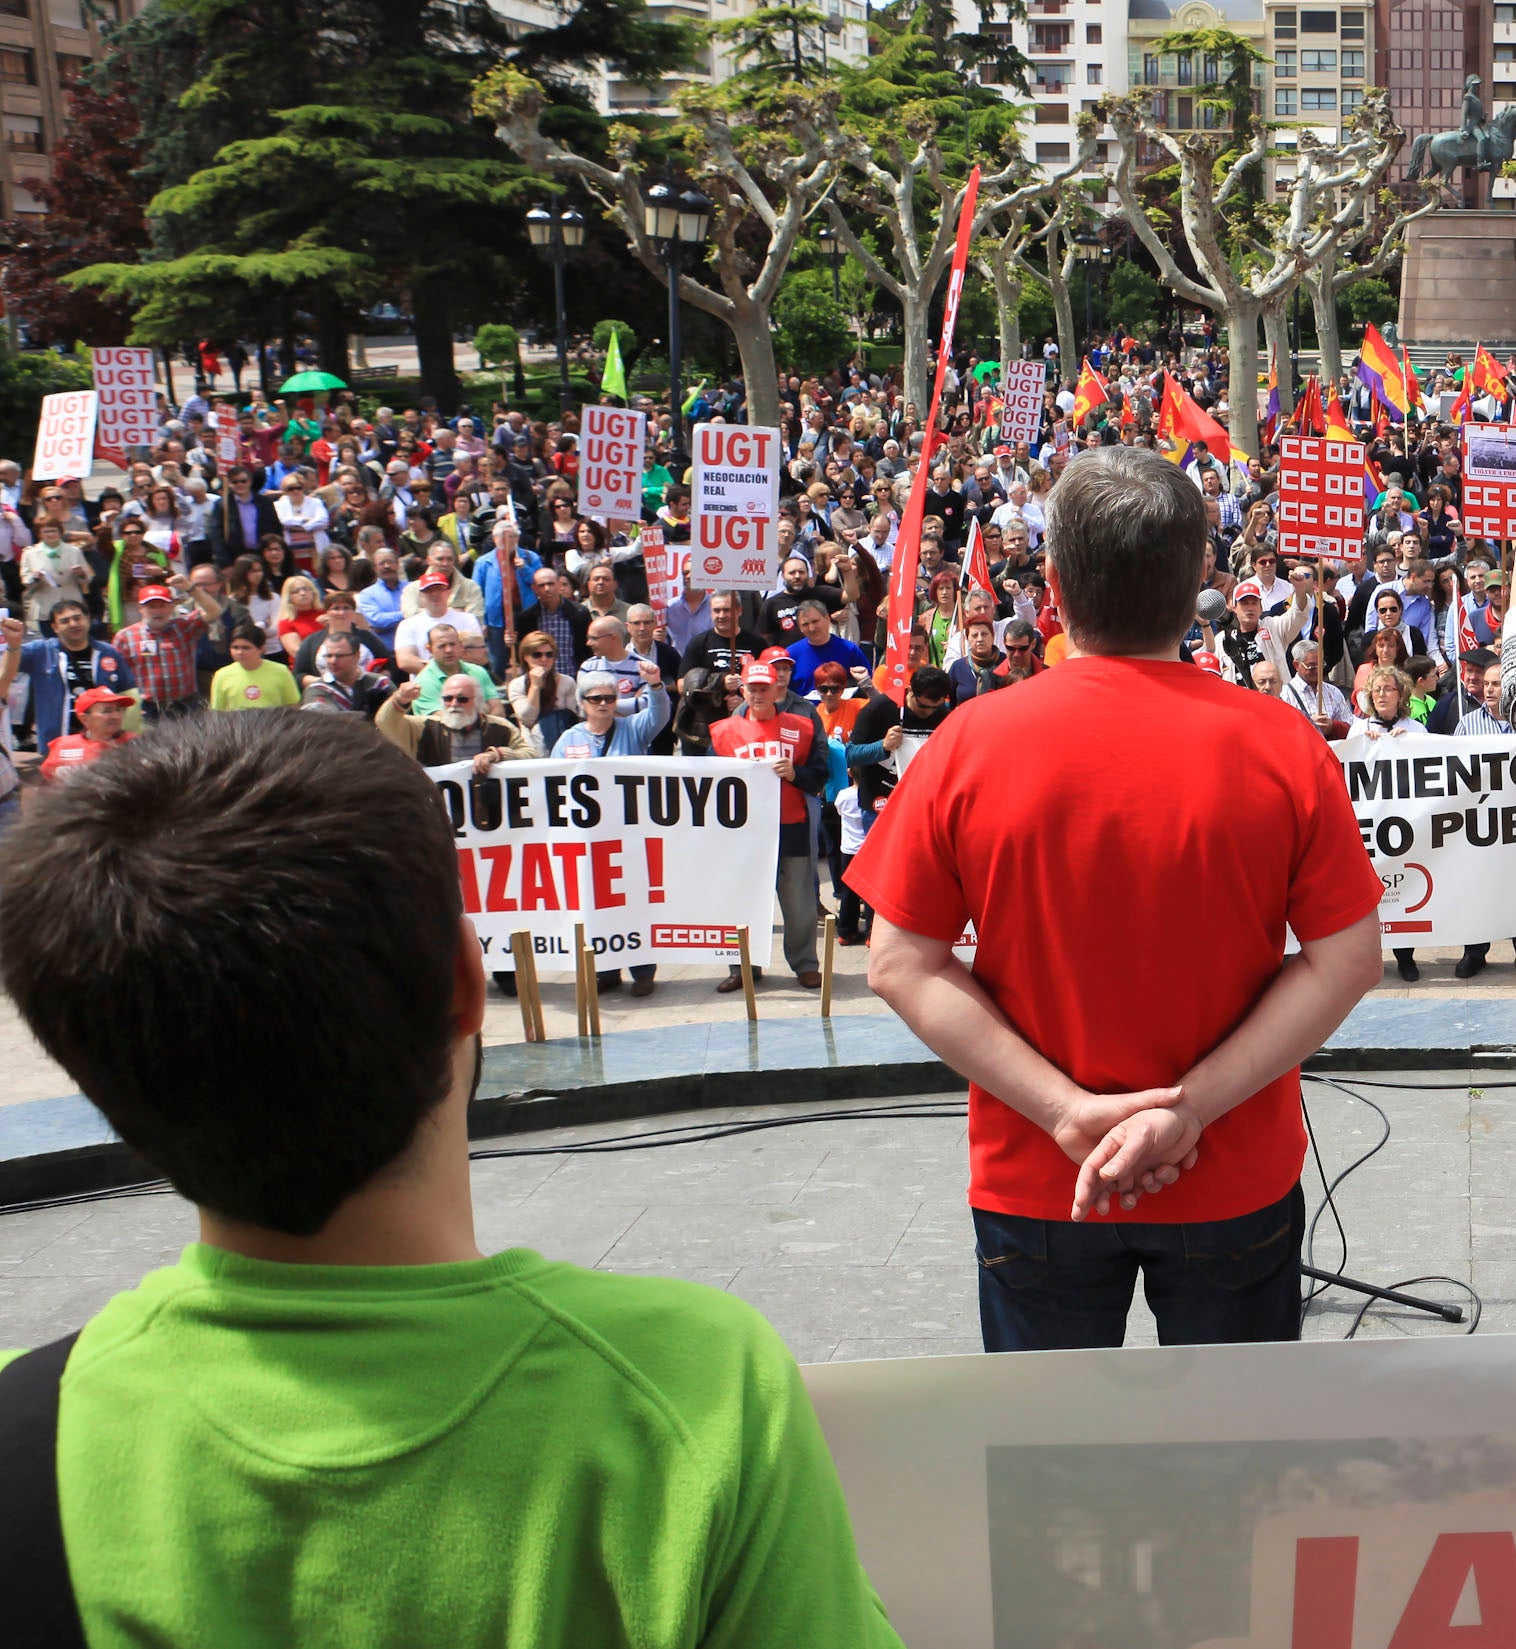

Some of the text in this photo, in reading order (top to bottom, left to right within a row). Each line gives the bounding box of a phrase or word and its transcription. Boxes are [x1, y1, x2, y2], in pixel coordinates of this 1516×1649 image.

[95, 350, 150, 366] UGT
[1010, 361, 1044, 377] UGT
[97, 370, 152, 385] UGT
[1007, 377, 1042, 393] UGT
[100, 389, 153, 405] UGT
[1005, 394, 1040, 409] UGT
[49, 395, 90, 416] UGT
[101, 409, 155, 425] UGT
[588, 410, 638, 440] UGT
[1003, 410, 1038, 425] UGT
[45, 416, 88, 437] UGT
[1001, 426, 1036, 441] UGT
[103, 428, 157, 445] UGT
[43, 438, 87, 458] UGT
[587, 439, 638, 467] UGT
[702, 431, 771, 468] UGT
[585, 466, 637, 494] UGT
[703, 471, 769, 485] NEGOCIACIÓN
[703, 485, 726, 496] REAL
[703, 503, 738, 513] DERECHOS
[701, 515, 770, 550] UGT
[436, 774, 749, 838] QUE ES TUYO
[479, 932, 642, 955] Y JBILDOS
[655, 929, 721, 943] CCOO
